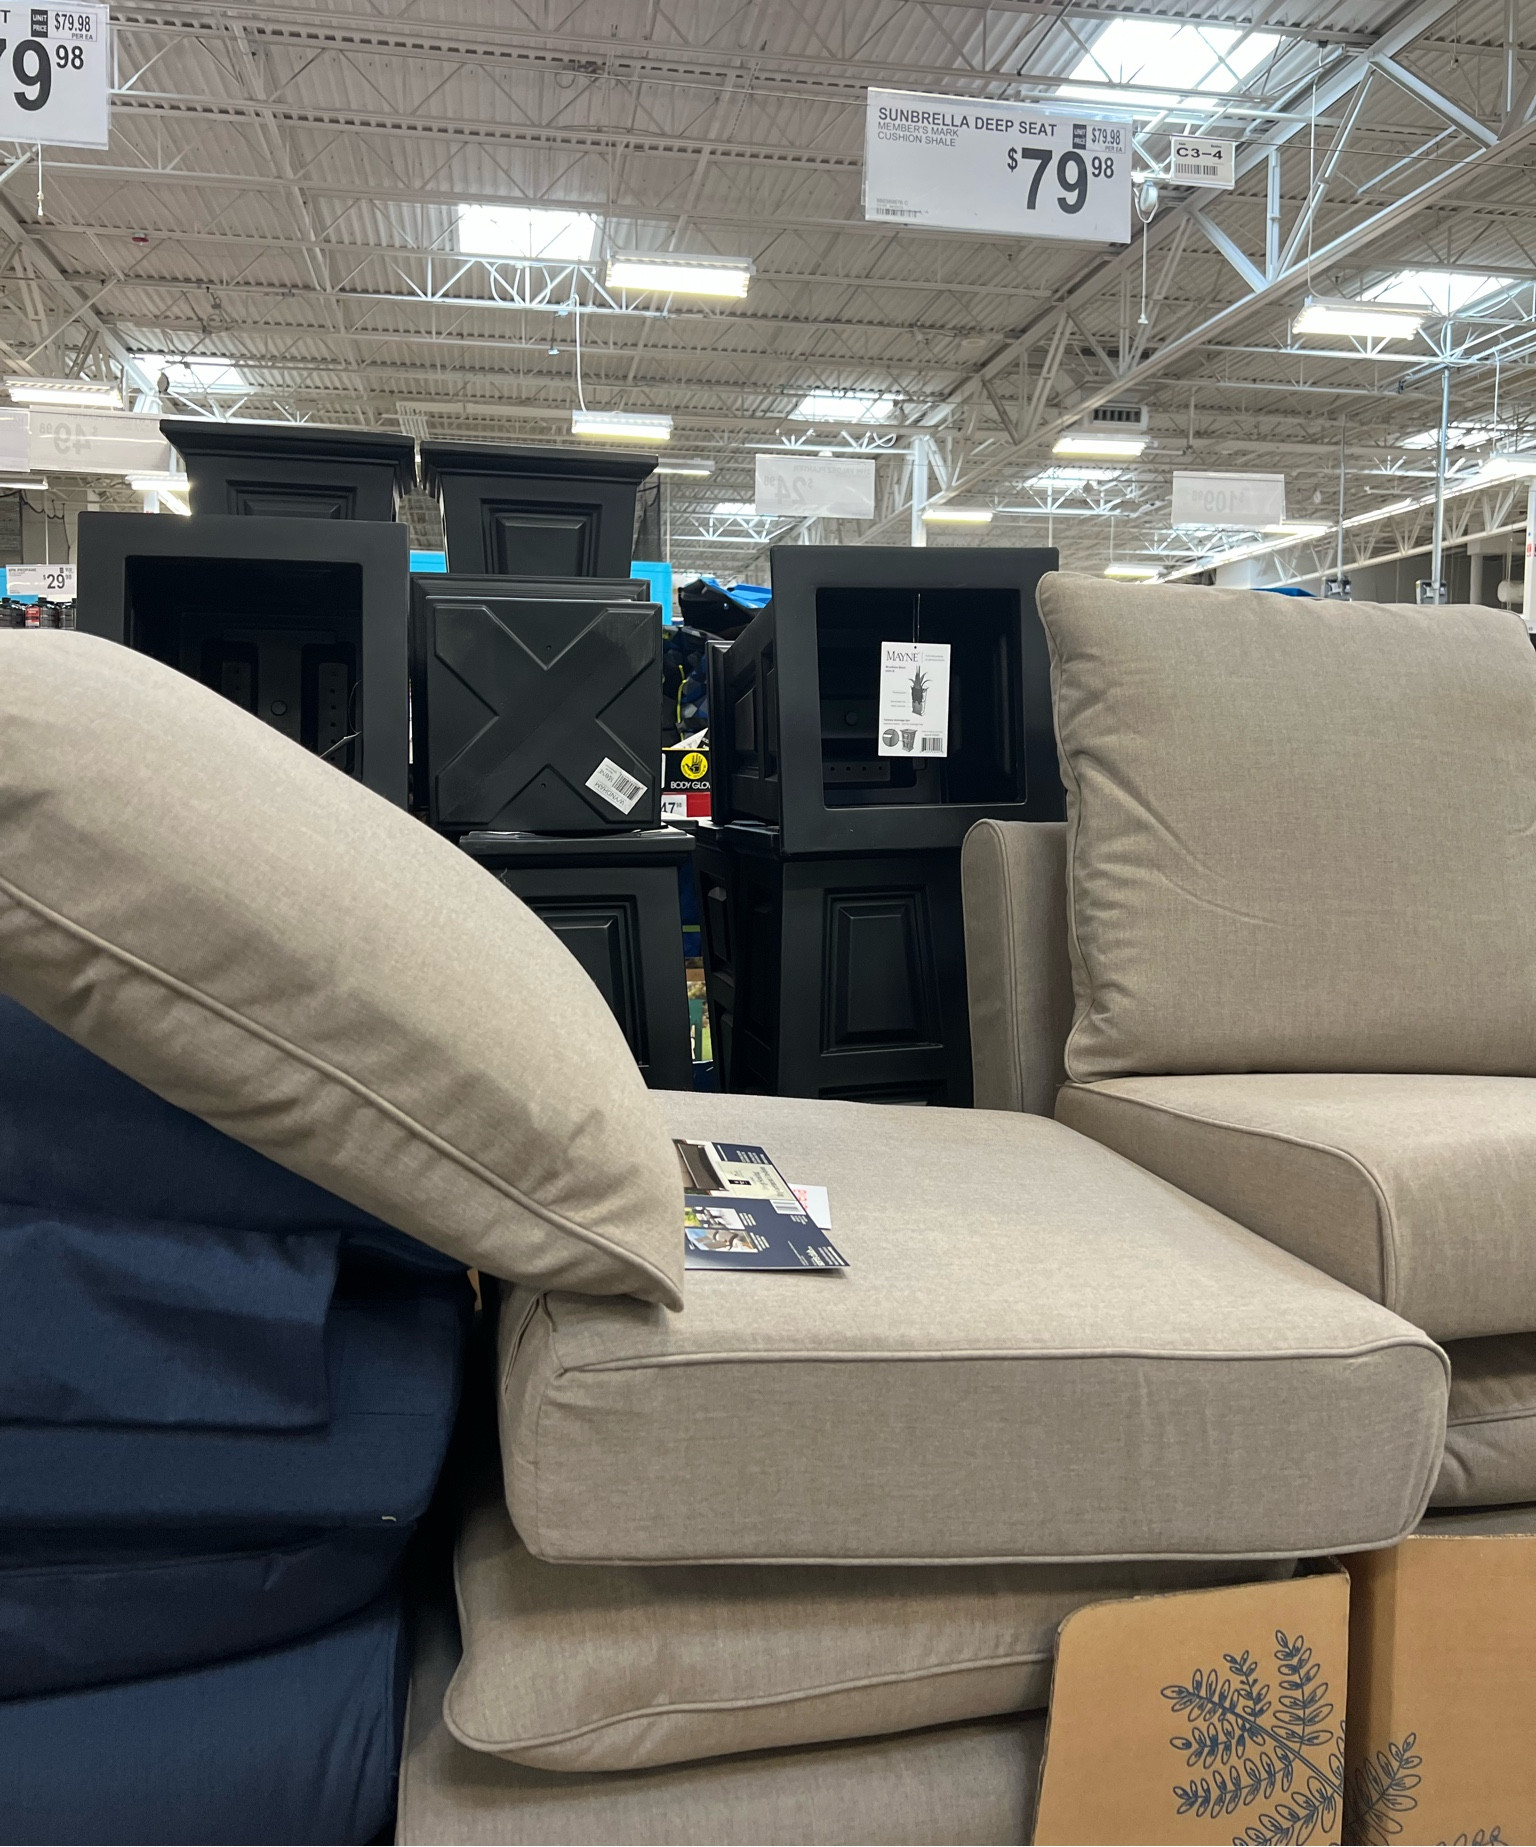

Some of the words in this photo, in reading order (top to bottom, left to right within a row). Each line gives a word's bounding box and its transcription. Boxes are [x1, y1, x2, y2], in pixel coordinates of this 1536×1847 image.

[32, 14, 47, 22] UNIT
[54, 11, 91, 32] $79.98
[32, 24, 47, 32] PRICE
[71, 32, 83, 40] PER
[0, 38, 52, 111] 9
[878, 107, 970, 129] SUNBRELLA
[975, 117, 1014, 132] DEEP
[1018, 121, 1057, 137] SEAT
[878, 121, 929, 135] MEMBER'S
[931, 127, 959, 138] MARK
[877, 131, 922, 144] CUSHION
[924, 136, 956, 147] SHALE
[1091, 127, 1121, 146] $79.98
[1176, 147, 1223, 160] C3-4
[887, 650, 919, 663] MAYNE
[670, 781, 691, 789] BODY
[594, 782, 625, 806] WYNDHAM
